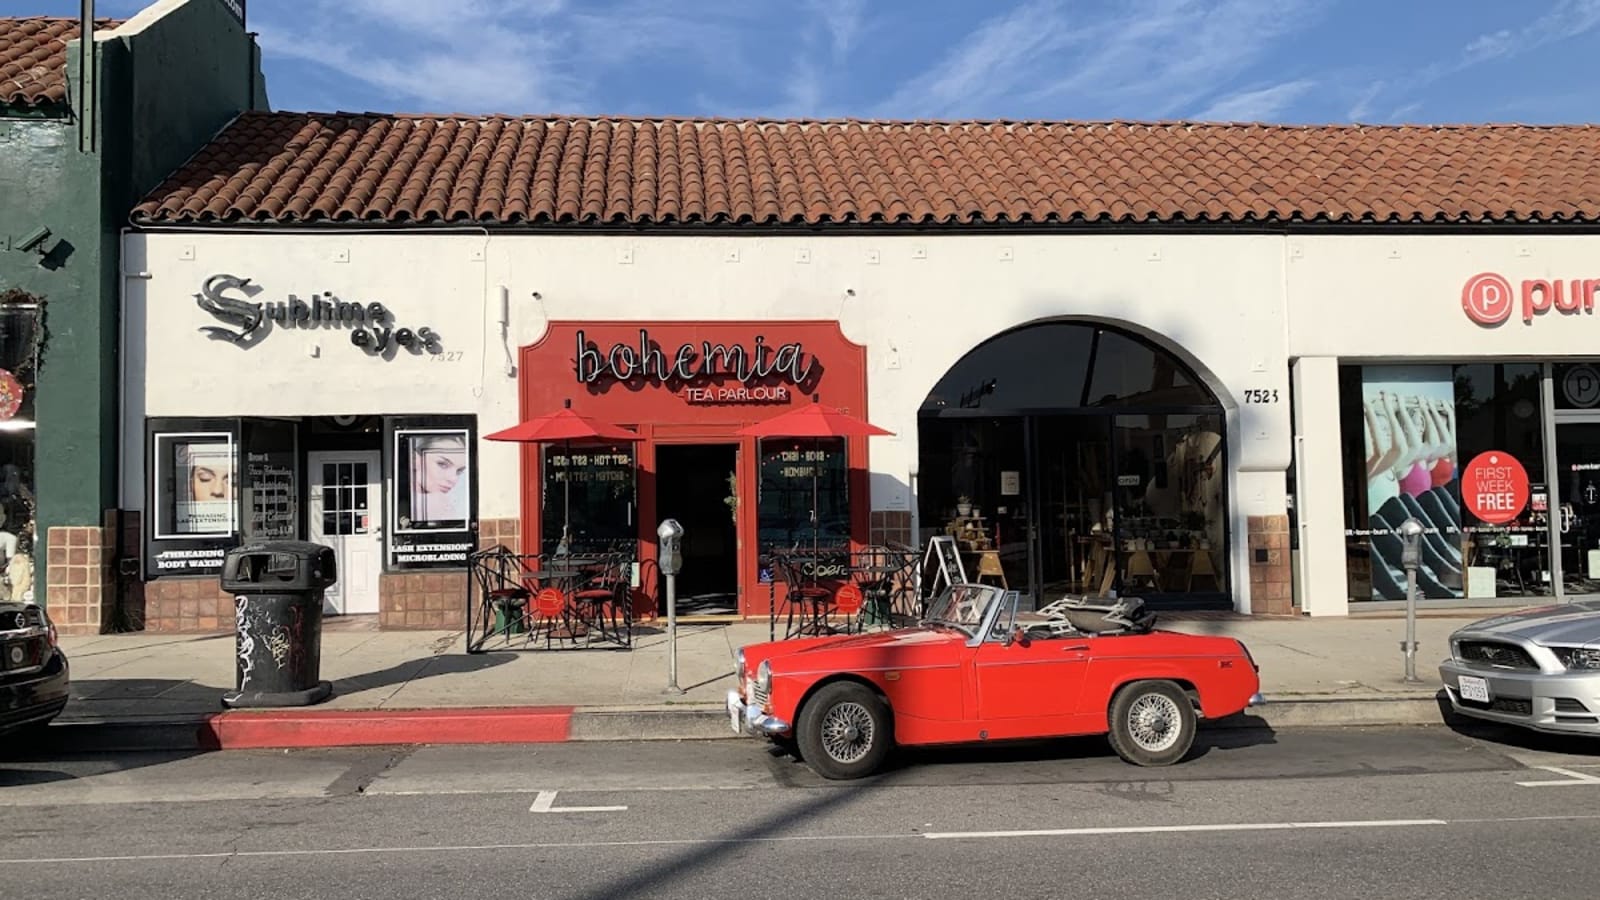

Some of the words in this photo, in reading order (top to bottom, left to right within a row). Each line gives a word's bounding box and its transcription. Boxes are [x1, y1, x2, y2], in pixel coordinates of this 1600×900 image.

[192, 274, 387, 342] Sublime
[351, 326, 441, 353] eyes
[576, 330, 810, 383] bohemia
[687, 388, 713, 400] TEA
[718, 387, 786, 400] PARLOUR
[594, 455, 610, 466] HOT
[1475, 466, 1512, 480] FIRST
[1476, 480, 1514, 492] WEEK
[1476, 492, 1516, 511] FREE
[157, 560, 187, 569] BODY
[187, 559, 224, 568] WAXIN
[397, 553, 467, 562] MICROBLADING
